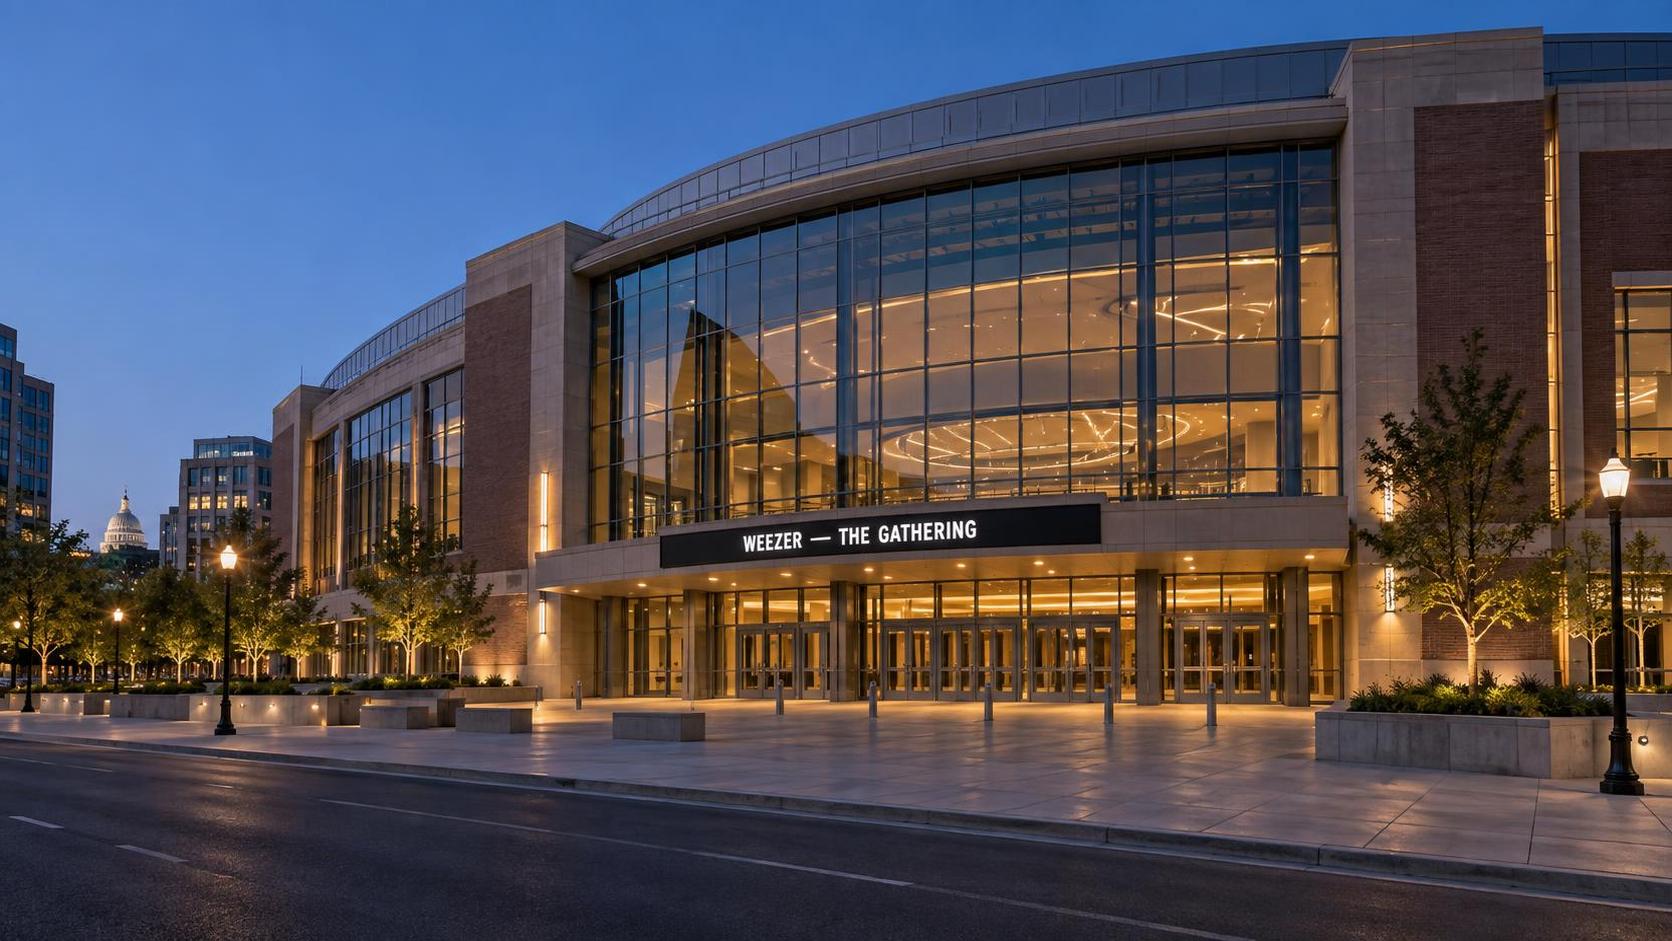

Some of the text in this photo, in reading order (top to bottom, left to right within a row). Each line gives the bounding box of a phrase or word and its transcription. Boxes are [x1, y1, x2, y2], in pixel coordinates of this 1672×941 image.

[743, 531, 803, 553] WEEZER
[839, 526, 870, 546] THE
[878, 519, 977, 544] GATHERING
